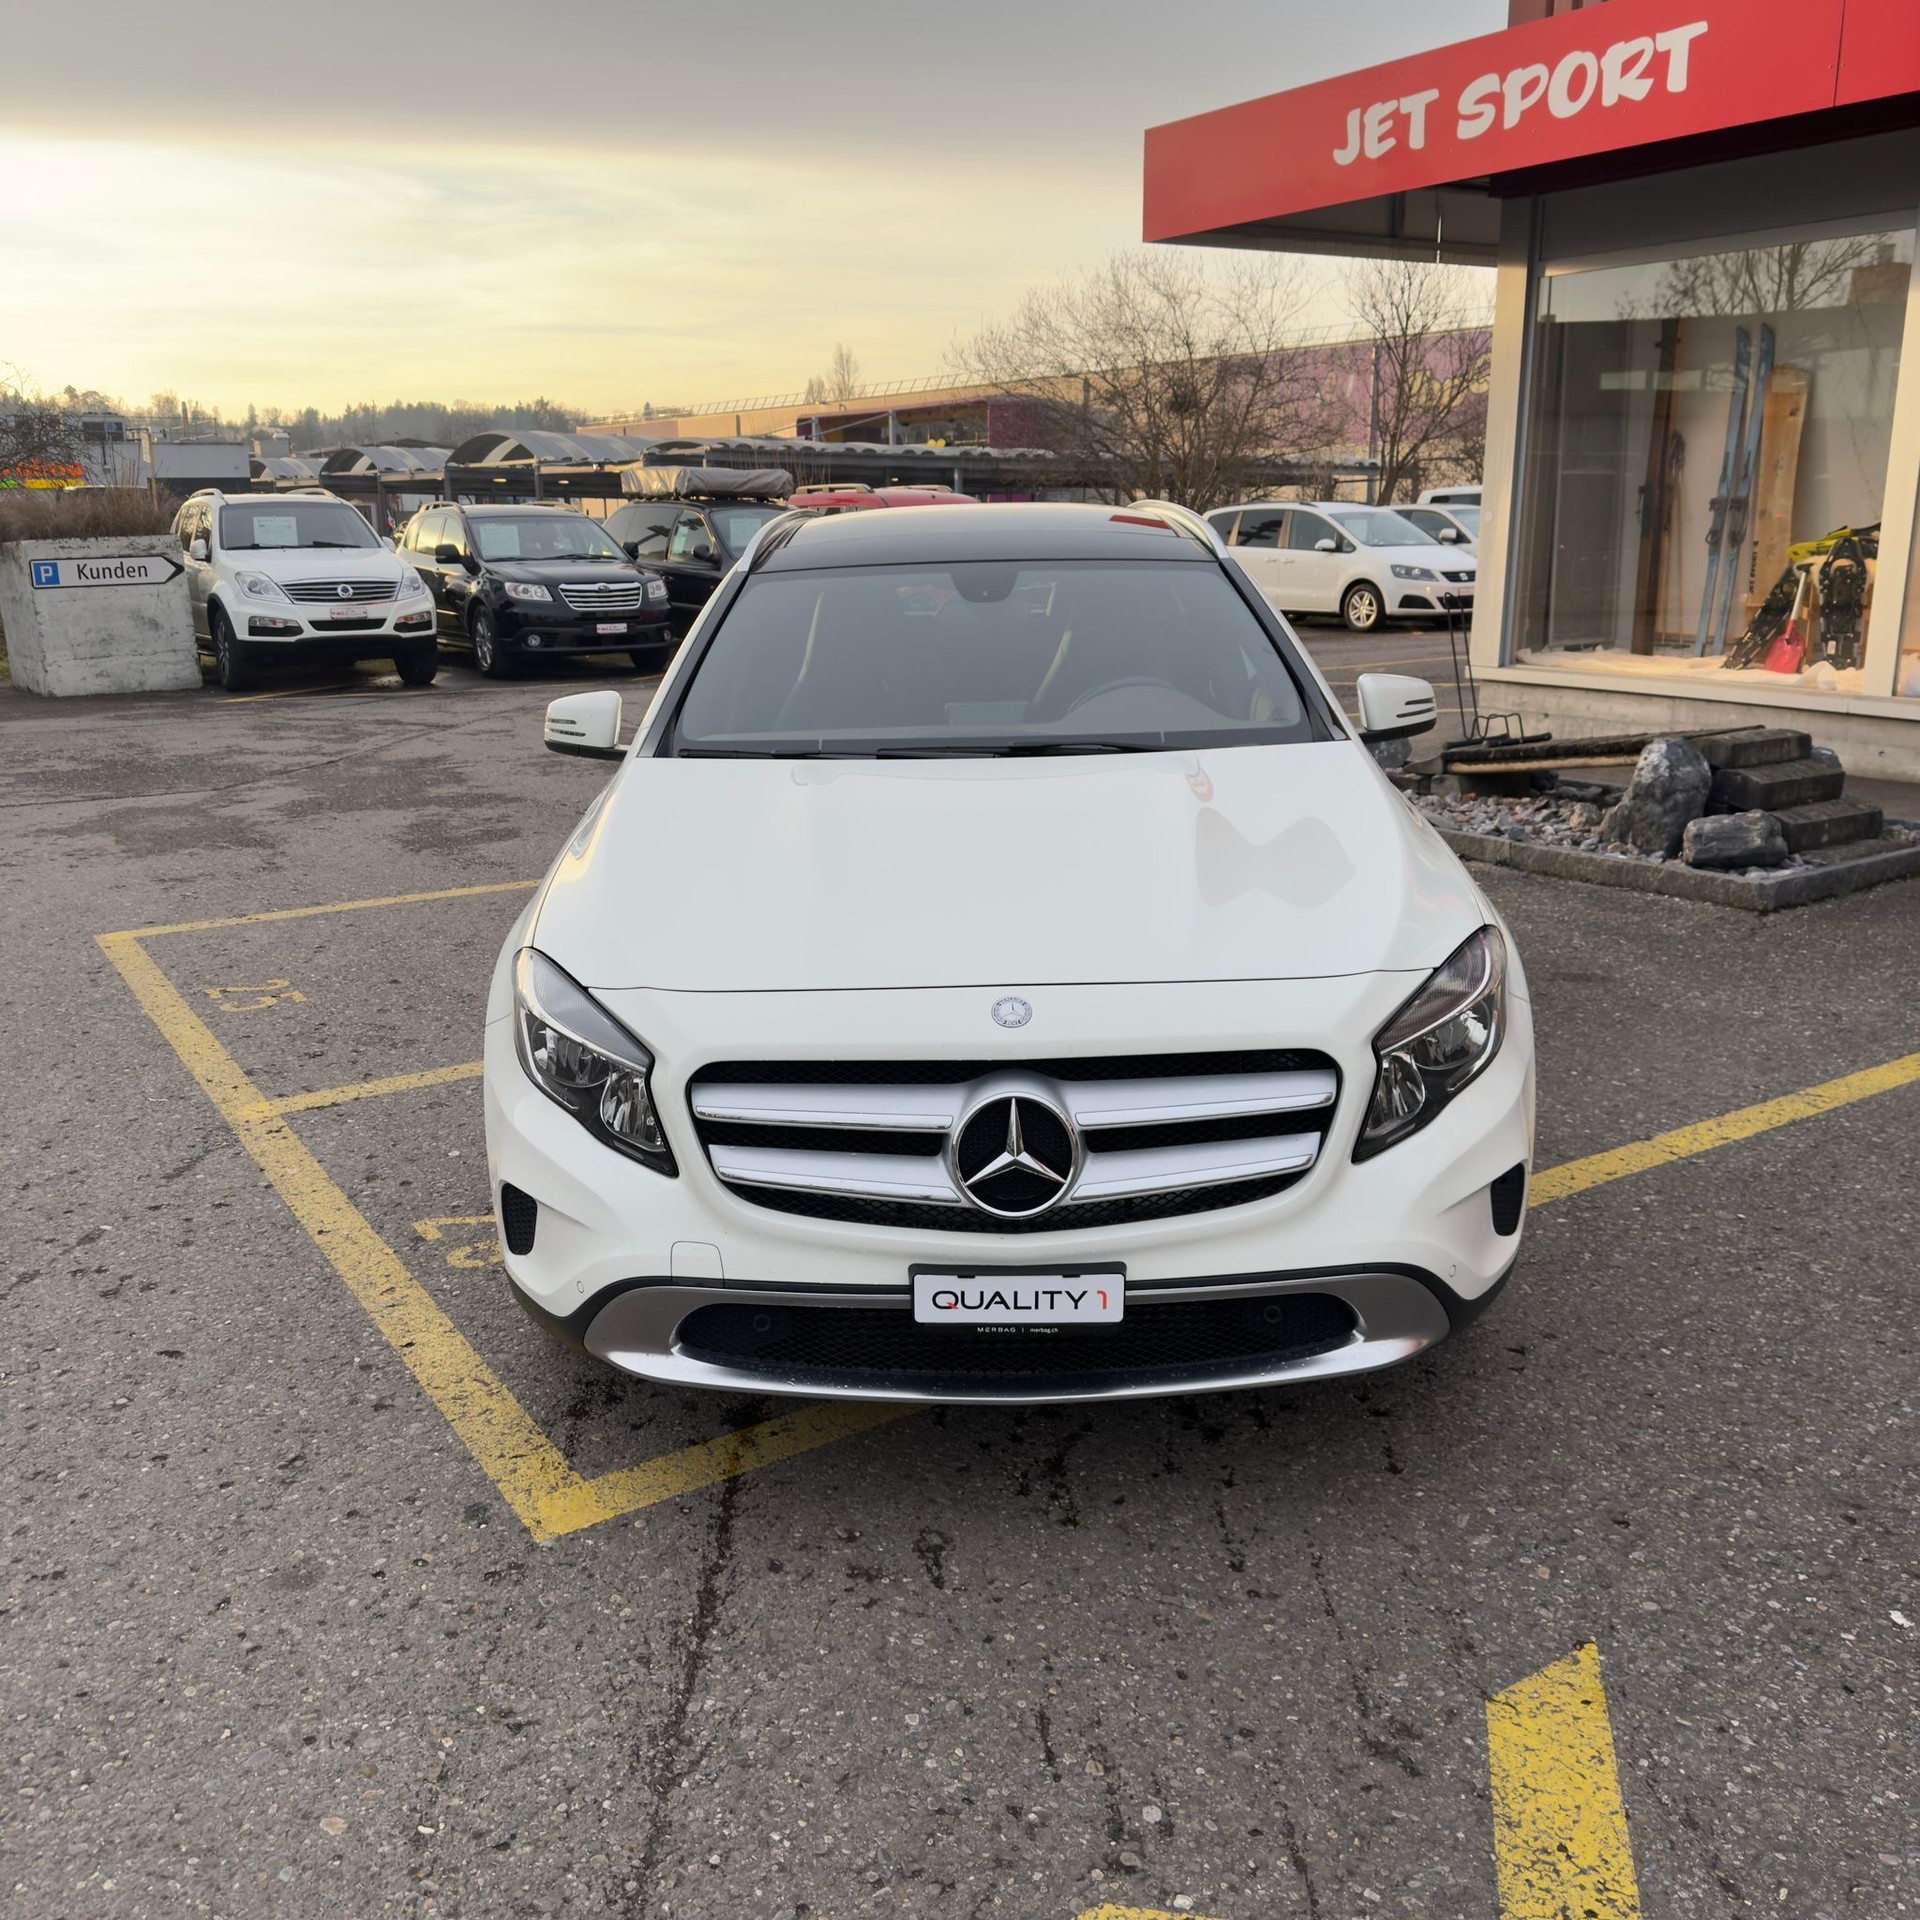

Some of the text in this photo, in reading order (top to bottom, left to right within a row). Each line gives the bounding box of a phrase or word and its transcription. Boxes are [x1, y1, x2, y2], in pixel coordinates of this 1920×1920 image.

[1332, 20, 1709, 167] JET SPORT
[39, 560, 149, 583] P Kunden
[931, 1290, 1108, 1310] QUALITY 1
